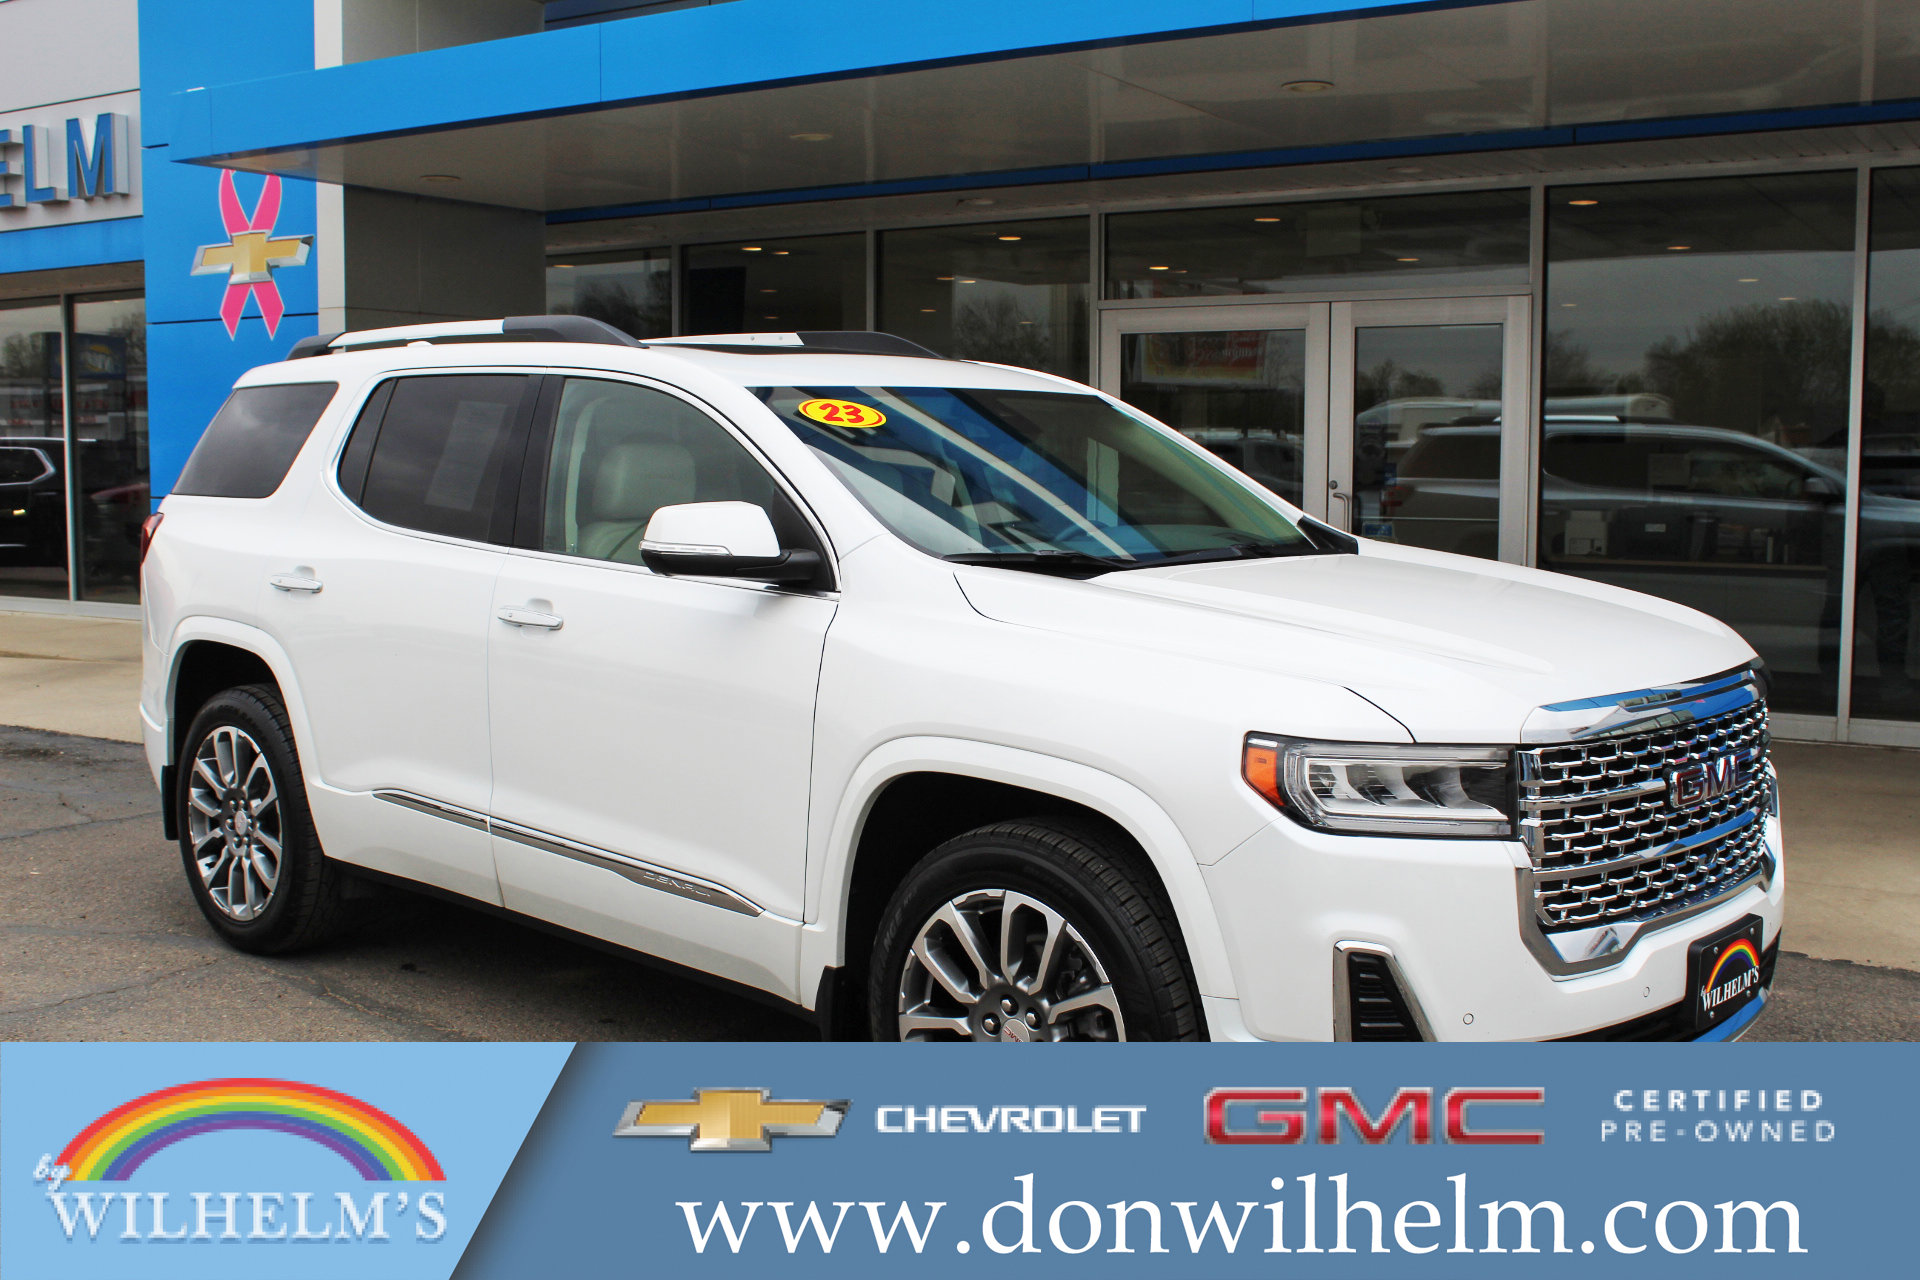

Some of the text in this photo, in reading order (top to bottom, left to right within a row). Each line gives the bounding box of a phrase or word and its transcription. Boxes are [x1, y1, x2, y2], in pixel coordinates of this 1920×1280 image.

[819, 403, 865, 424] 23
[1669, 748, 1760, 808] GMC
[1702, 965, 1760, 1012] WILHELM'S
